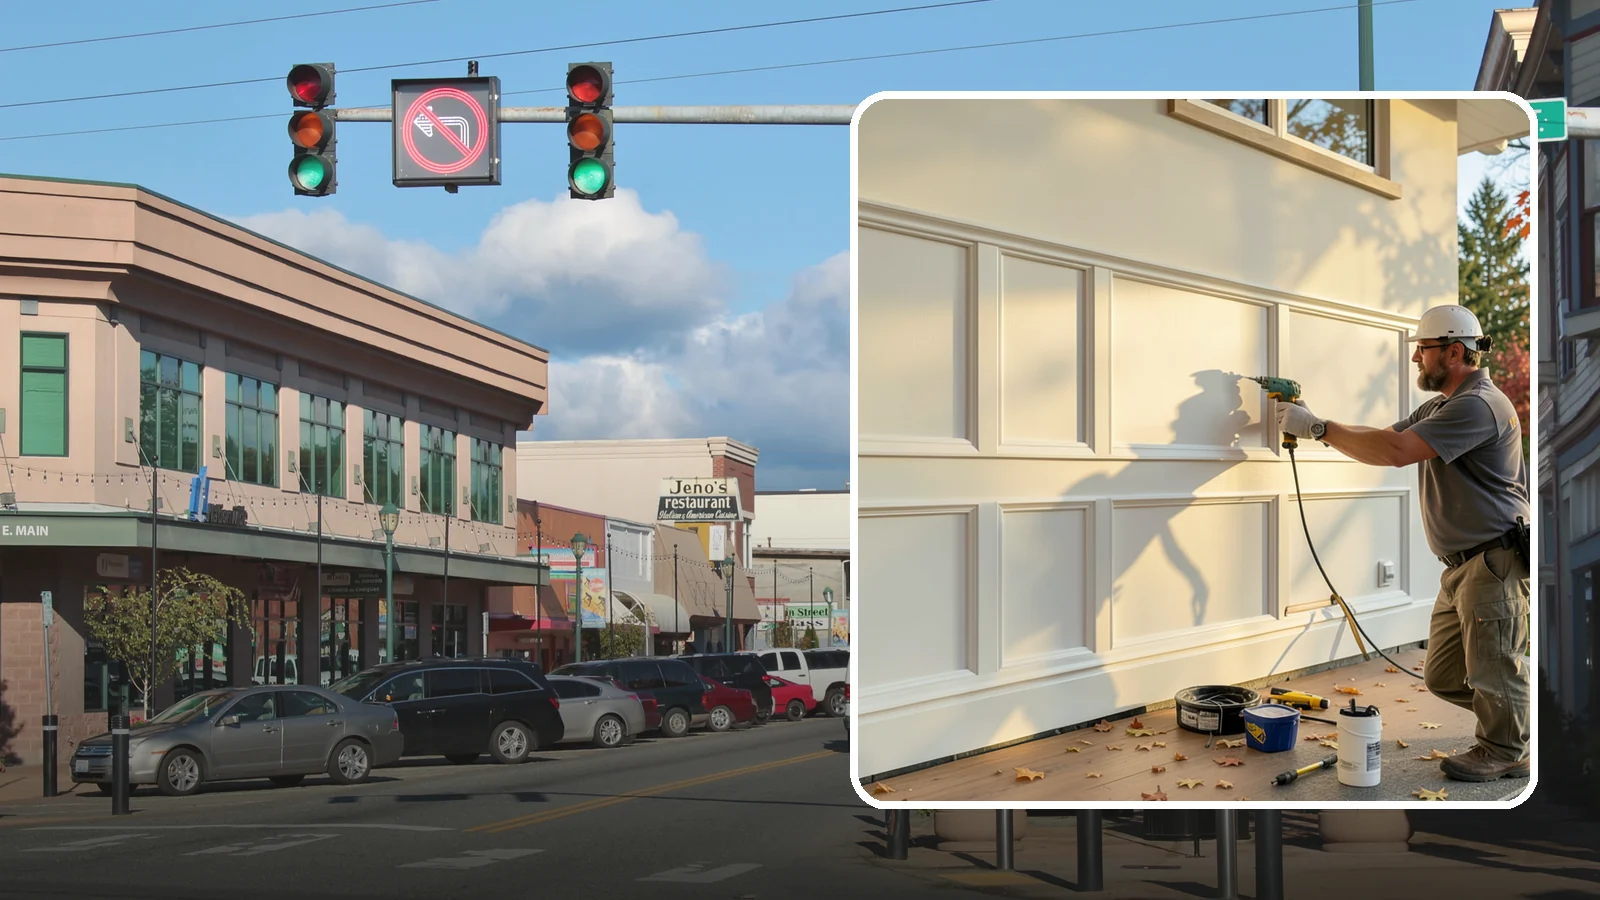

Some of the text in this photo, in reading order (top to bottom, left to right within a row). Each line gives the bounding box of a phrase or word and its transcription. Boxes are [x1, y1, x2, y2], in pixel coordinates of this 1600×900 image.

[669, 480, 728, 495] Jeno's
[665, 496, 731, 509] restaurant
[658, 509, 681, 519] Italian
[686, 509, 714, 519] American
[715, 509, 738, 519] Cuisine
[2, 525, 49, 536] E. MAIN
[797, 607, 829, 617] Street
